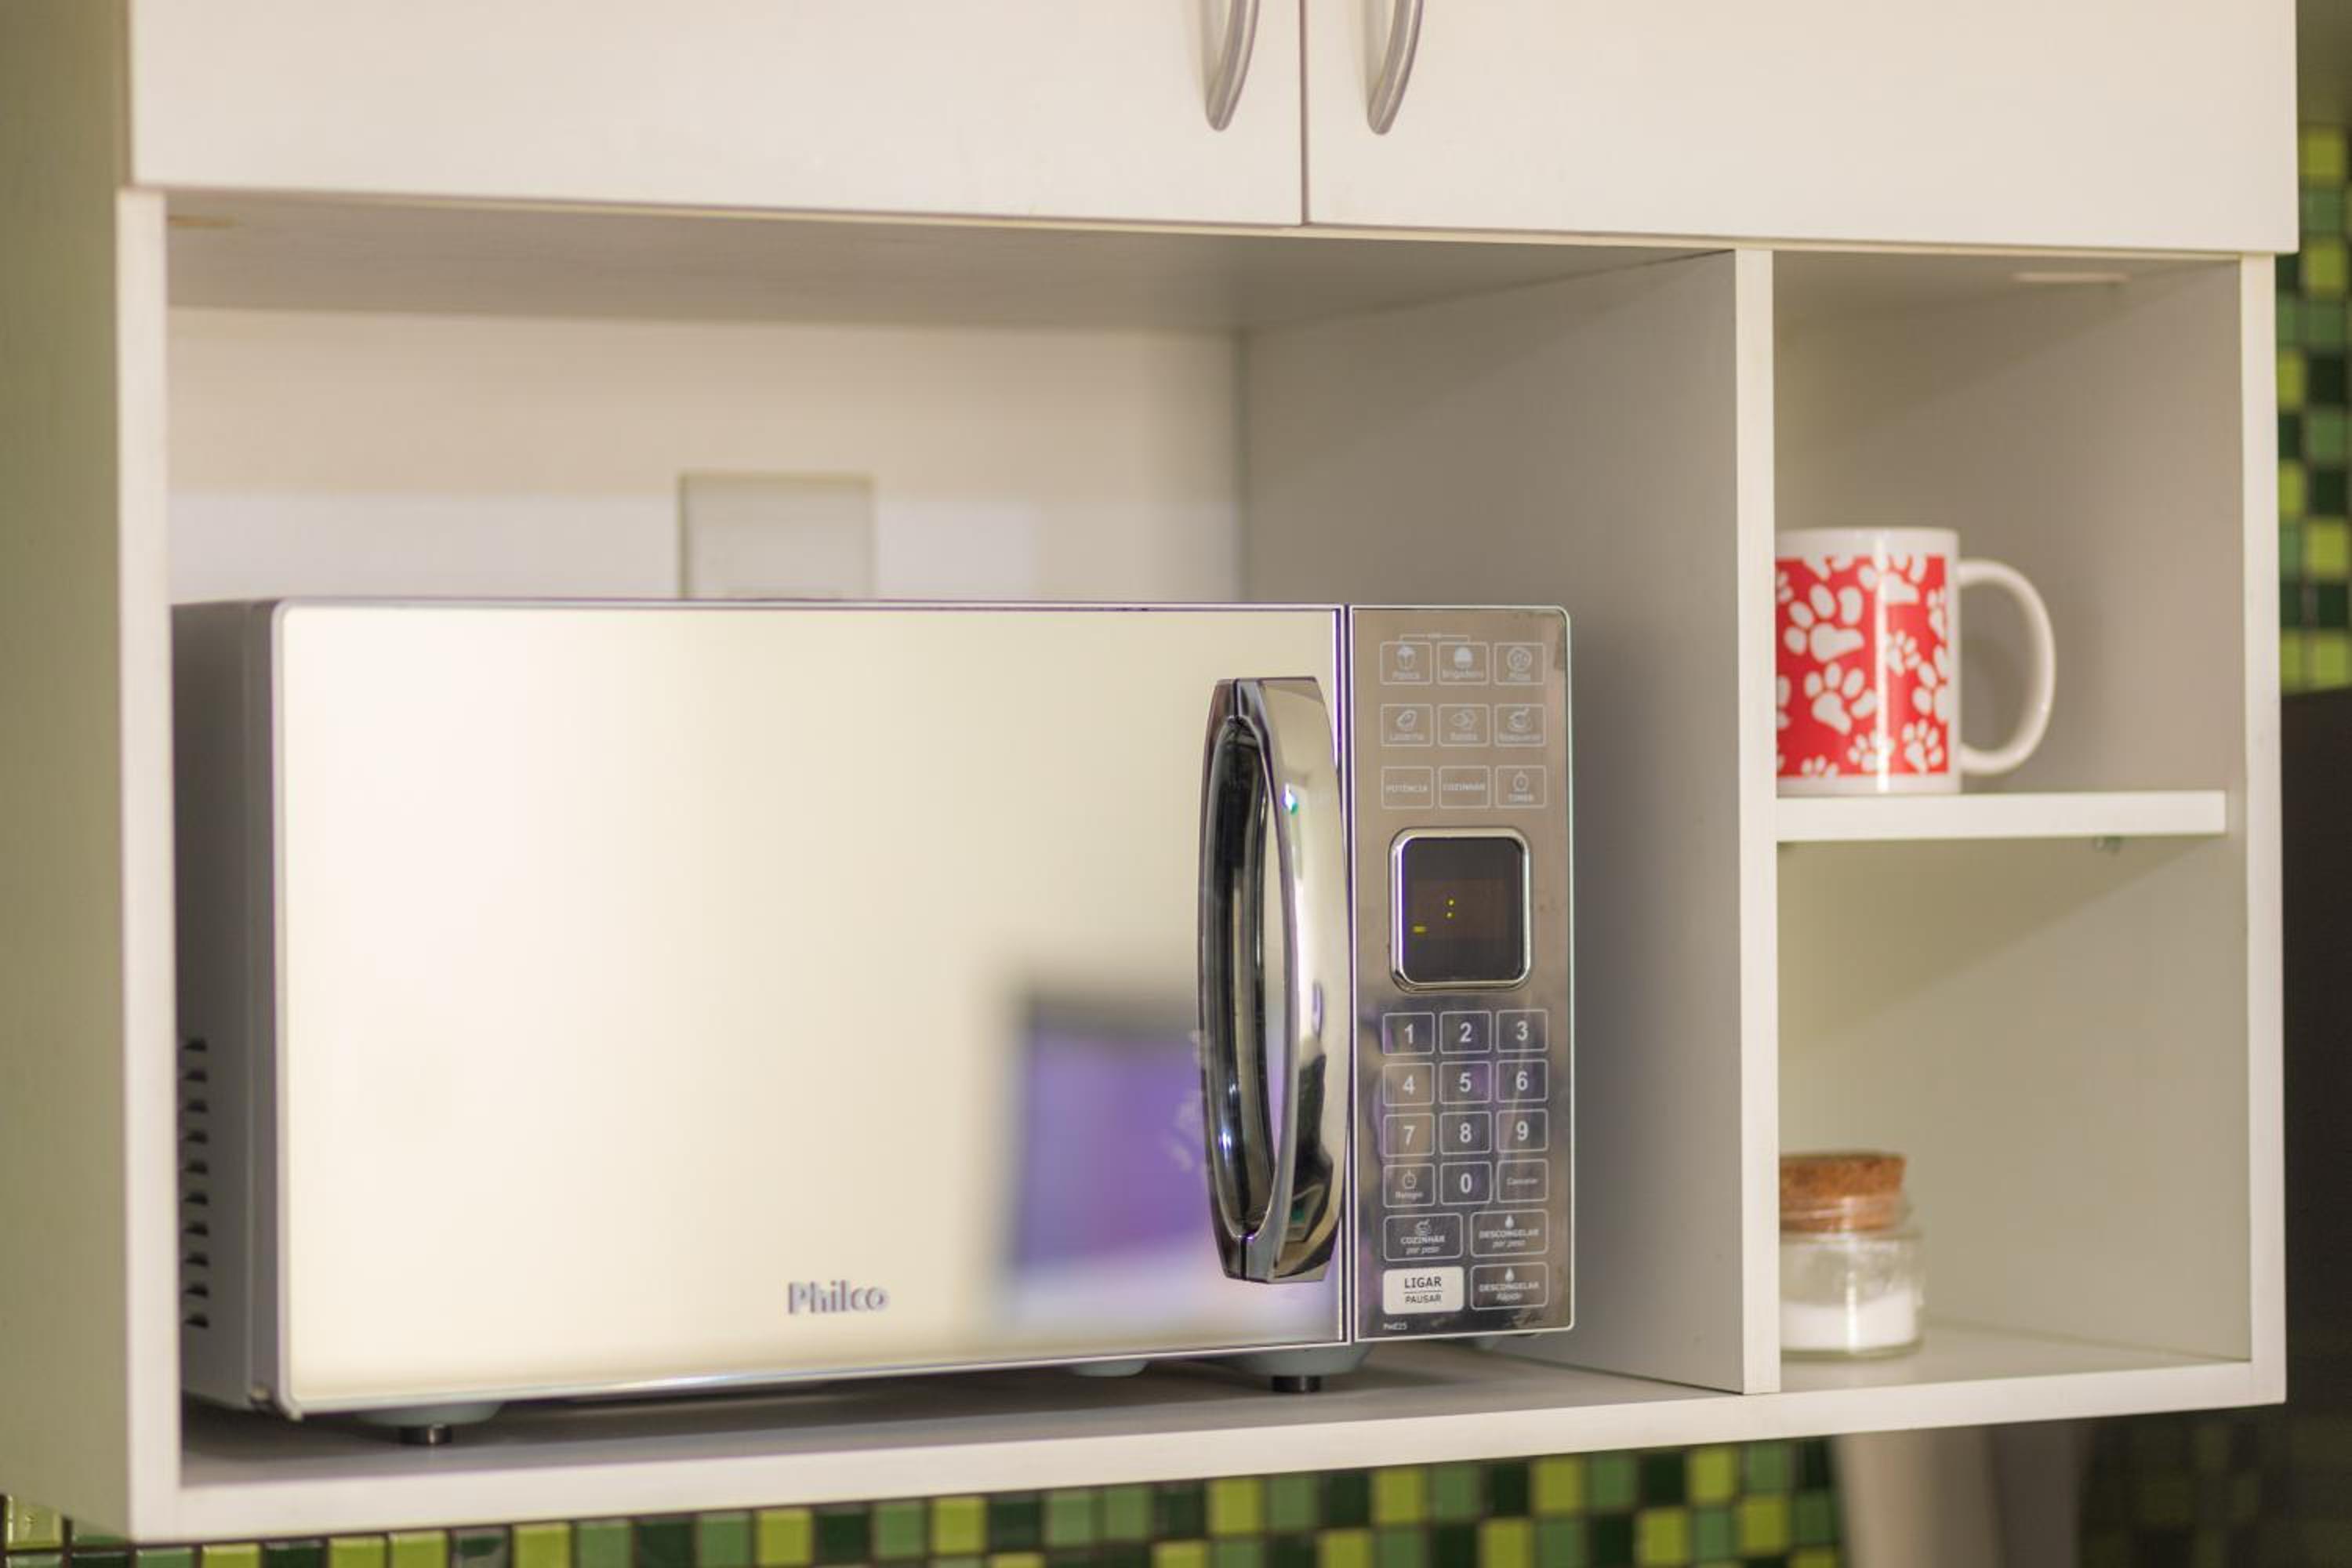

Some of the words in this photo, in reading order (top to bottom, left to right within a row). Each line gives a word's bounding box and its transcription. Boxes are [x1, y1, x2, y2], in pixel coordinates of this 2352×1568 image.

[1404, 1024, 1414, 1044] 1
[1459, 1022, 1472, 1043] 2
[1516, 1021, 1529, 1041] 3
[1403, 1076, 1415, 1094] 4
[1459, 1073, 1472, 1093] 5
[1515, 1071, 1529, 1091] 6
[1403, 1126, 1416, 1146] 7
[1459, 1123, 1472, 1143] 8
[1516, 1121, 1529, 1142] 9
[1460, 1173, 1472, 1194] 0
[1400, 1235, 1446, 1245] COZINHAR
[1404, 1276, 1443, 1289] LIGAR
[788, 1279, 887, 1314] Philco
[1405, 1294, 1442, 1304] PAUSAR
